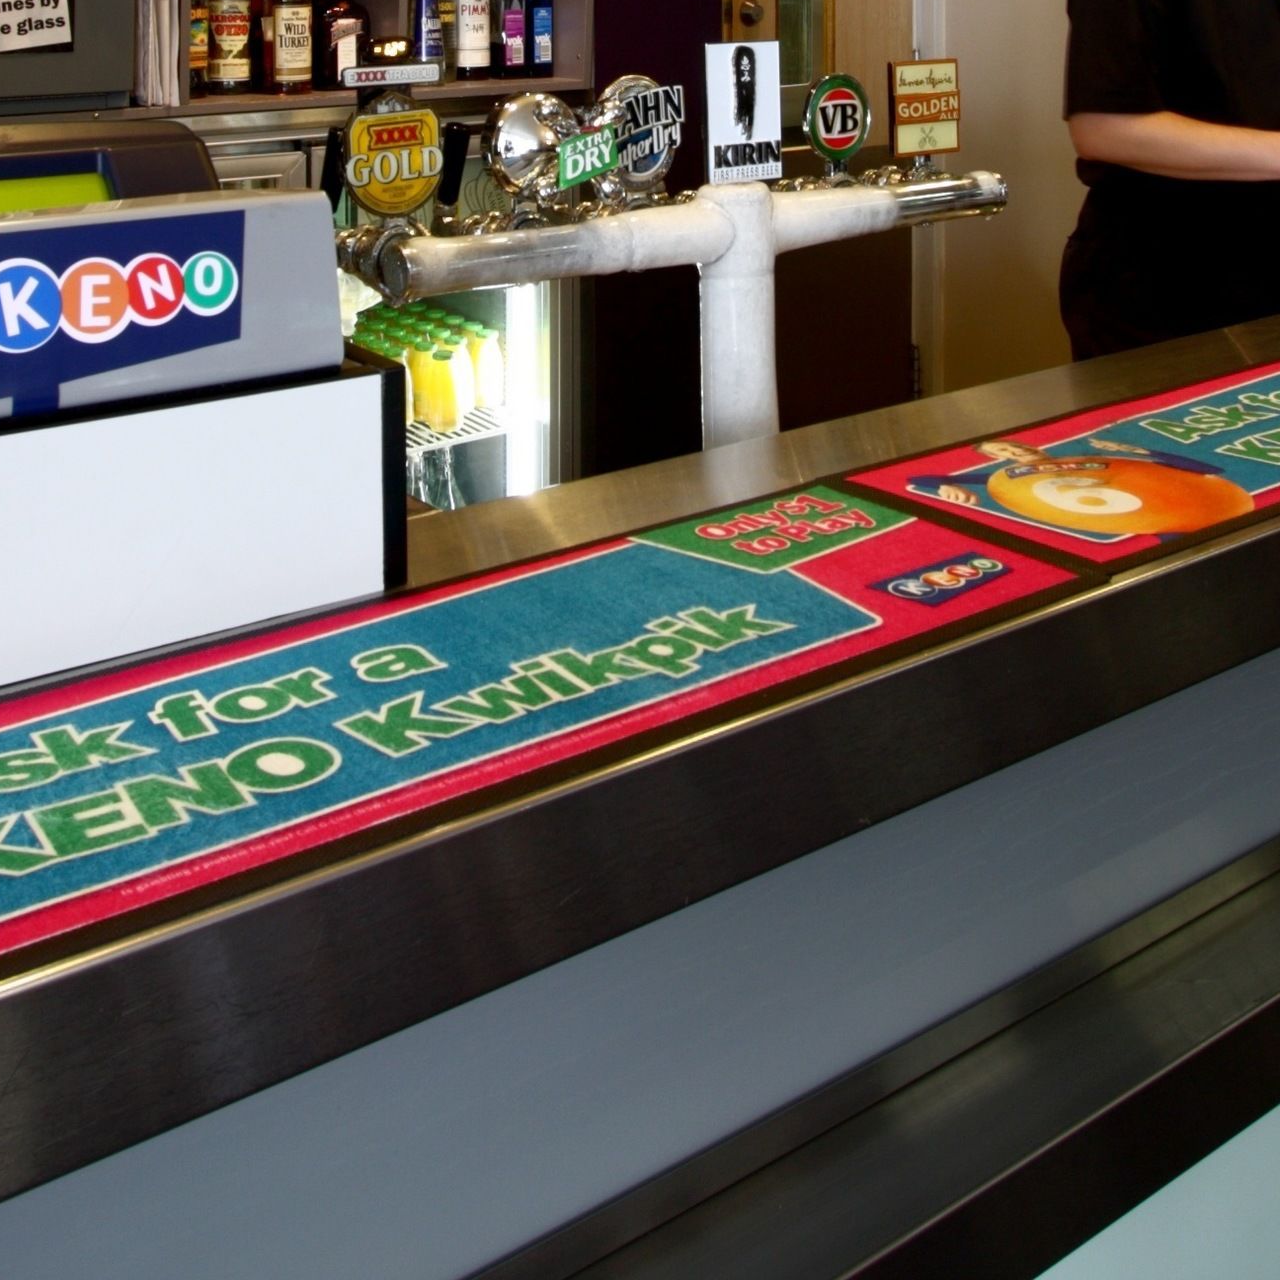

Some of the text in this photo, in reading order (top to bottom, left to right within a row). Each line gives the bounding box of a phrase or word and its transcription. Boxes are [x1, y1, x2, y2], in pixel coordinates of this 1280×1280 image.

[16, 16, 66, 36] glass
[278, 35, 310, 49] TURKEY
[283, 22, 307, 36] WILD
[819, 103, 859, 135] VB
[898, 96, 959, 118] GOLDEN
[940, 111, 959, 120] ALE
[371, 124, 419, 146] XXXX
[565, 130, 613, 158] EXTRA
[345, 146, 444, 188] GOLD
[565, 139, 617, 180] DRY
[714, 141, 781, 169] KIRIN
[1139, 405, 1280, 444] Ask
[1032, 476, 1144, 515] 6
[694, 493, 848, 540] Only $1
[731, 509, 877, 556] to Play
[896, 558, 997, 596] KENO
[149, 666, 338, 742] for
[349, 644, 449, 683] a
[333, 603, 798, 758] Kwikpik
[134, 866, 192, 891] gambling
[203, 848, 247, 870] problem
[269, 830, 296, 850] you?
